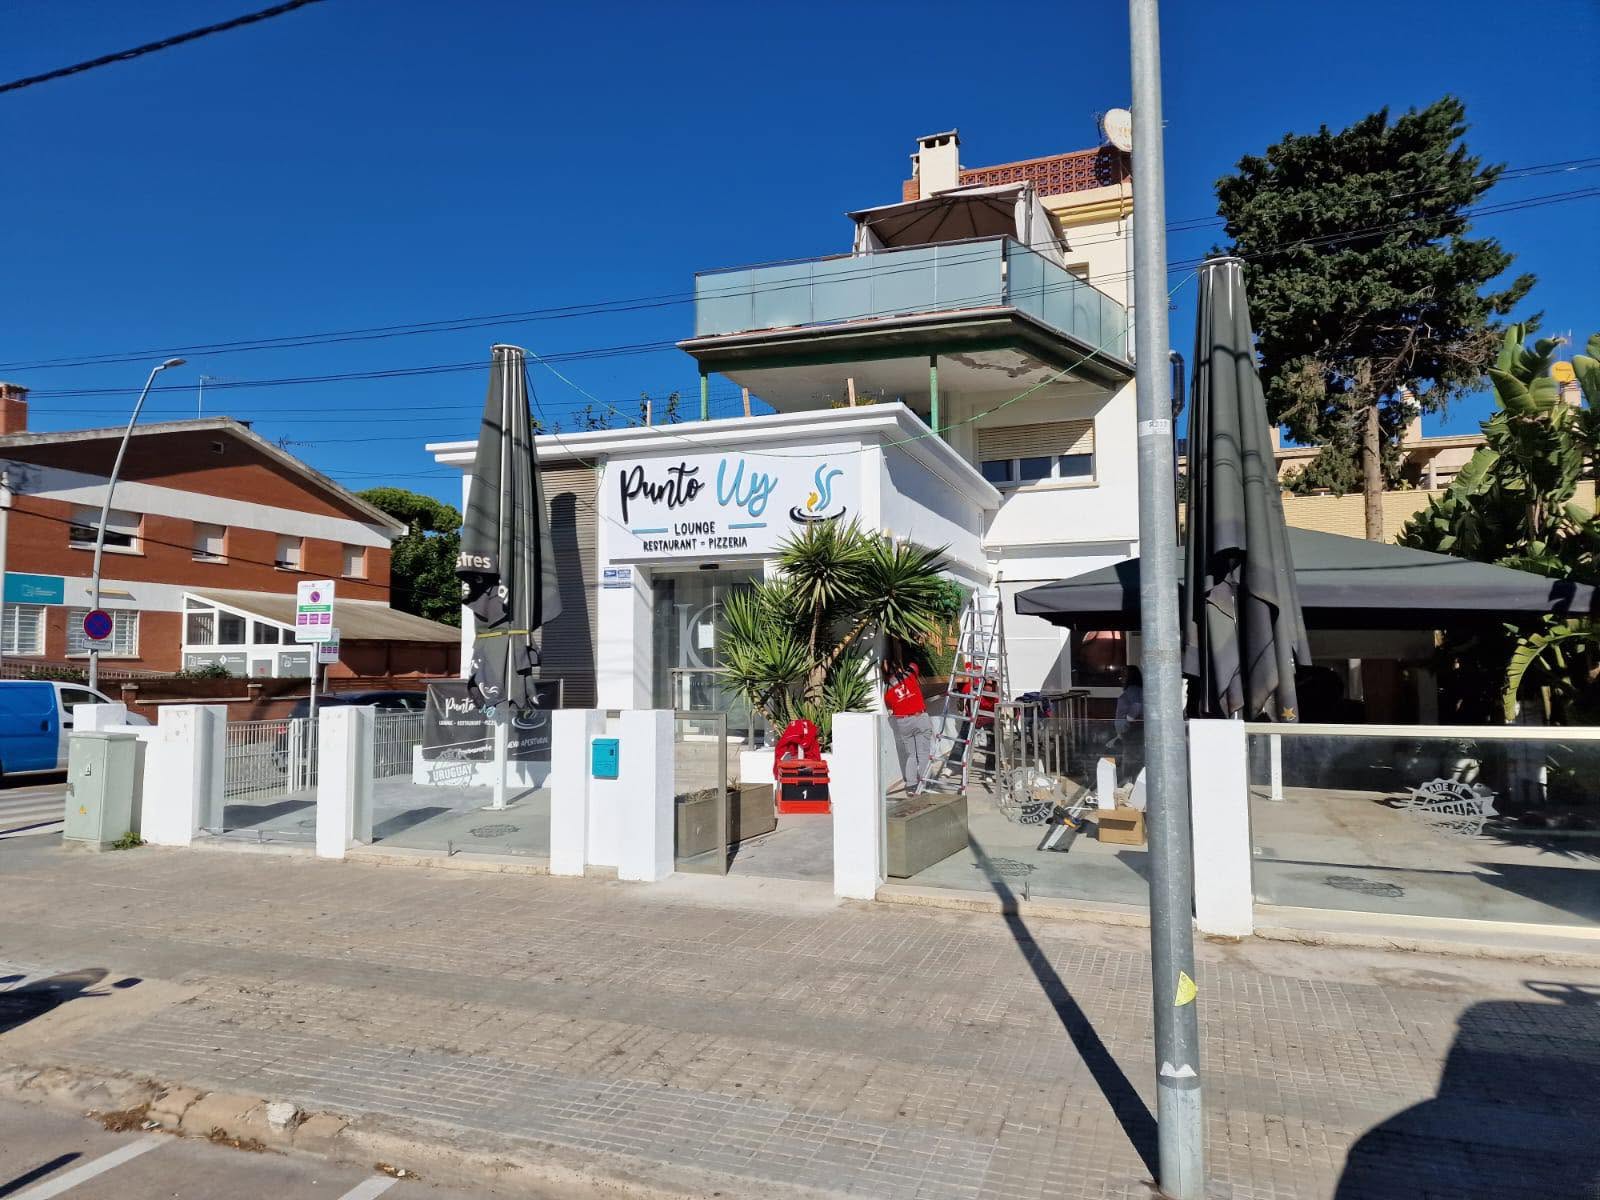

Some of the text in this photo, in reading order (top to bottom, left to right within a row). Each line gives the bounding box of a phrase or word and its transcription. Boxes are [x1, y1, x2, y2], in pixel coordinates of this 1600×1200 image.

[620, 458, 778, 524] Punto Uy
[674, 521, 716, 536] LOUNGE
[643, 538, 697, 552] RESTAURANT
[708, 536, 748, 549] PIZZERIA
[445, 697, 476, 718] Punto
[433, 763, 472, 781] URUGUAY
